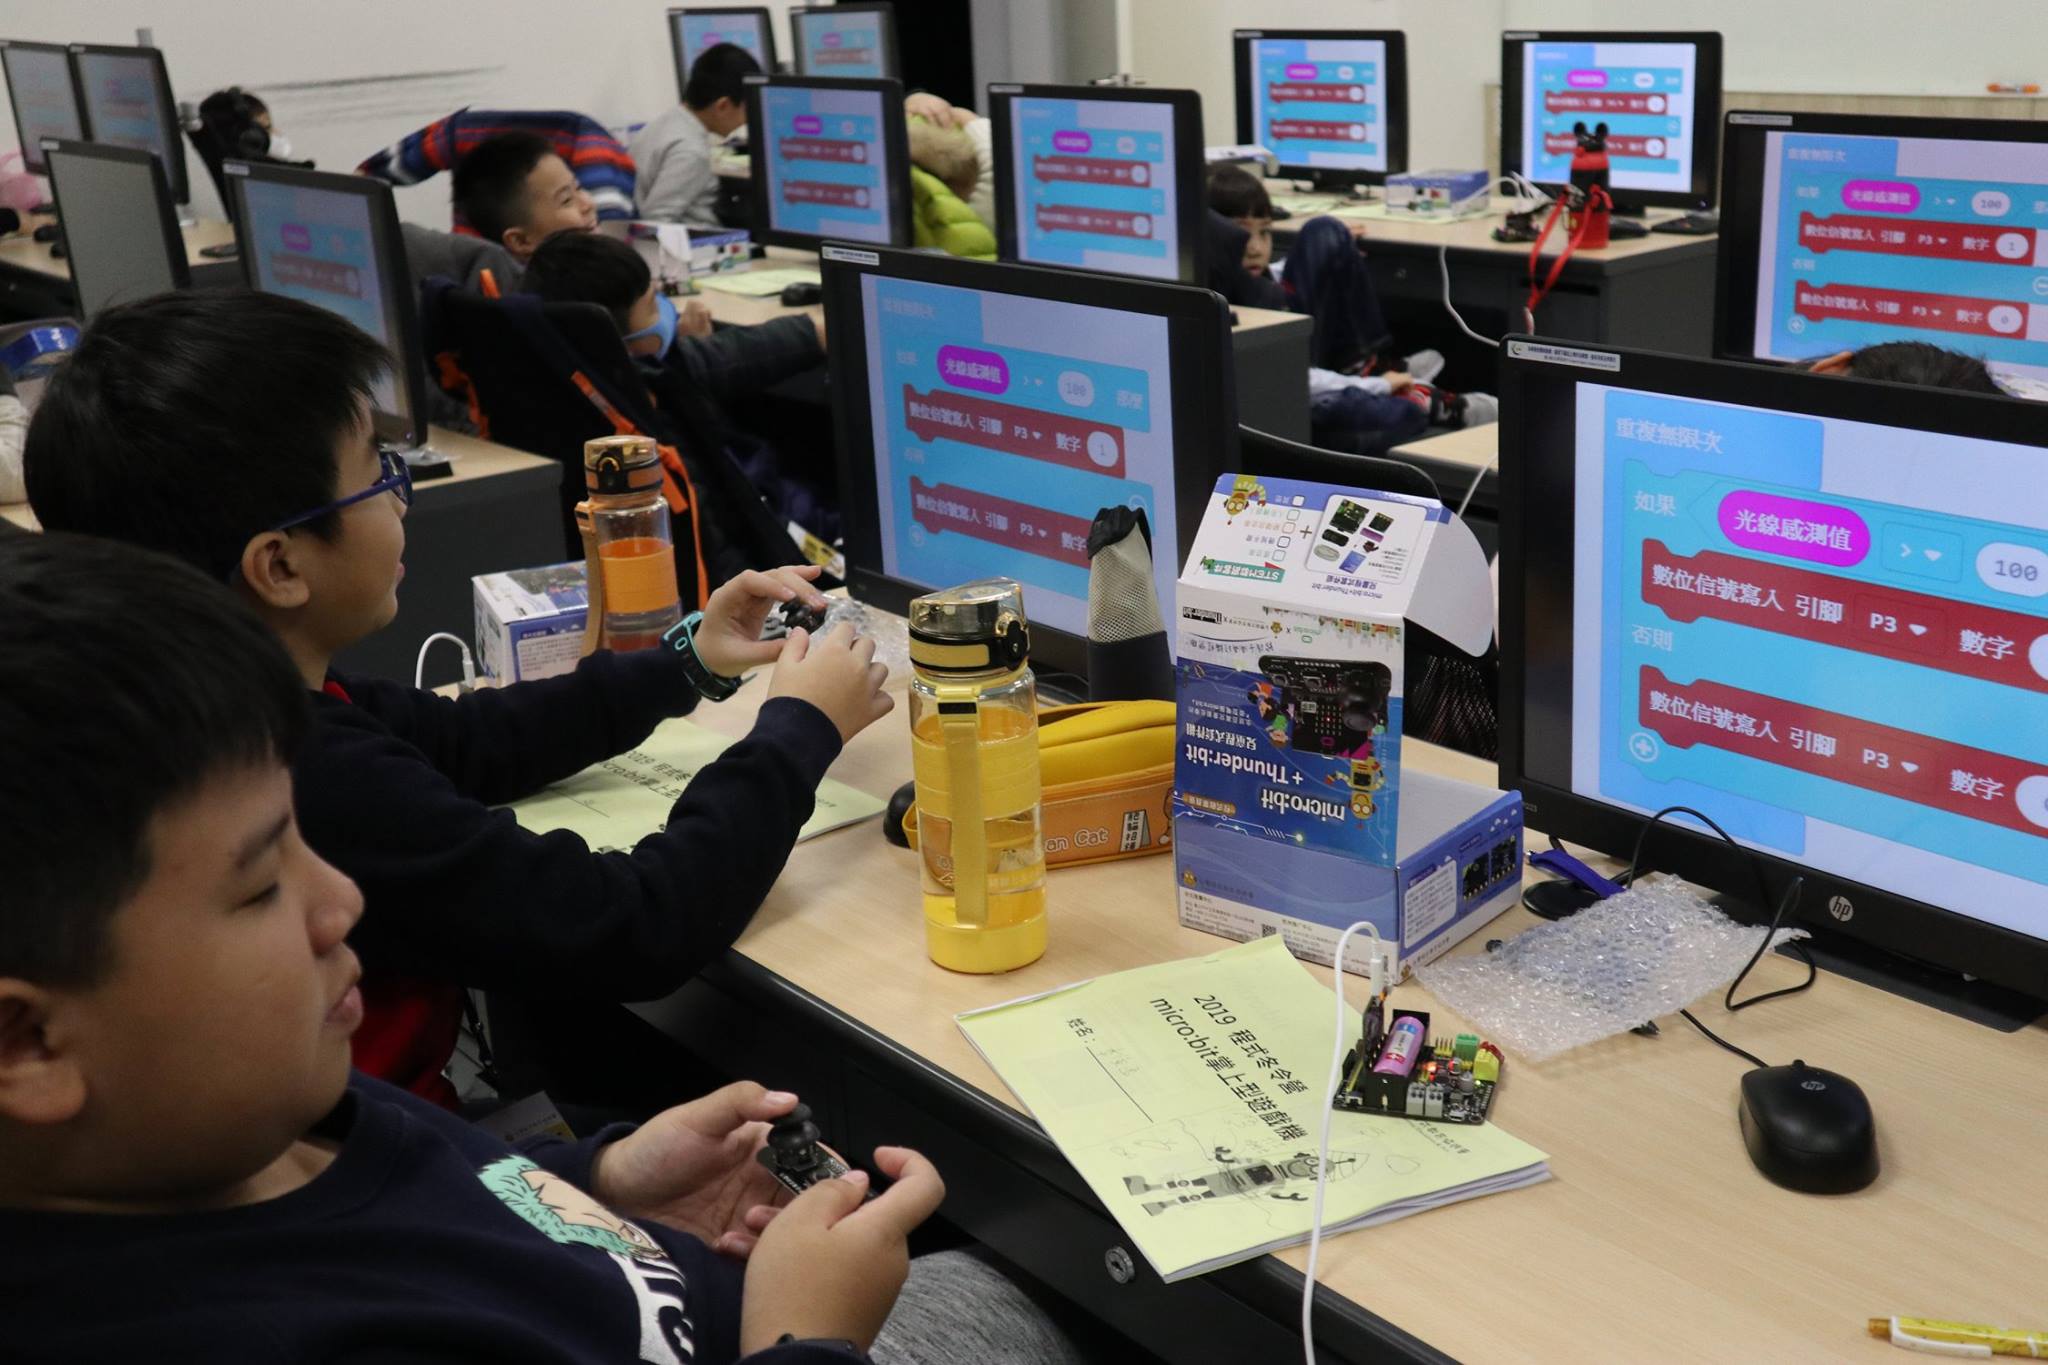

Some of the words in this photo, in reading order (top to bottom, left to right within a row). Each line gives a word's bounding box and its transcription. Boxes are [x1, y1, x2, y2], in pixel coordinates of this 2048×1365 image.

[1918, 235, 1933, 245] P3
[1912, 306, 1927, 317] P3
[1014, 425, 1028, 439] P3
[1616, 418, 1723, 455] 重複無限次
[1020, 523, 1034, 537] P3
[1634, 490, 1676, 518] 如果
[1734, 508, 1853, 552] 光線感測值
[1994, 559, 2038, 582] 100
[1653, 564, 1784, 613] 數位信號寫入
[1795, 594, 1844, 625] 引腳
[1870, 613, 1898, 634] P3
[1959, 628, 2014, 661] 數字
[1632, 624, 1673, 652] 否則
[1650, 690, 1779, 744] 數位信號寫入
[1790, 728, 1837, 758] 引腳
[1863, 749, 1889, 770] P3
[1950, 768, 2005, 801] 數字
[1186, 744, 1289, 785] Thunder:bit
[1261, 788, 1345, 822] micro:bit
[1074, 827, 1110, 848] Cat
[1193, 994, 1237, 1026] 2019
[1228, 1029, 1309, 1095] 程式冬令營
[1150, 998, 1308, 1141] micro:bit掌上型遊戲機
